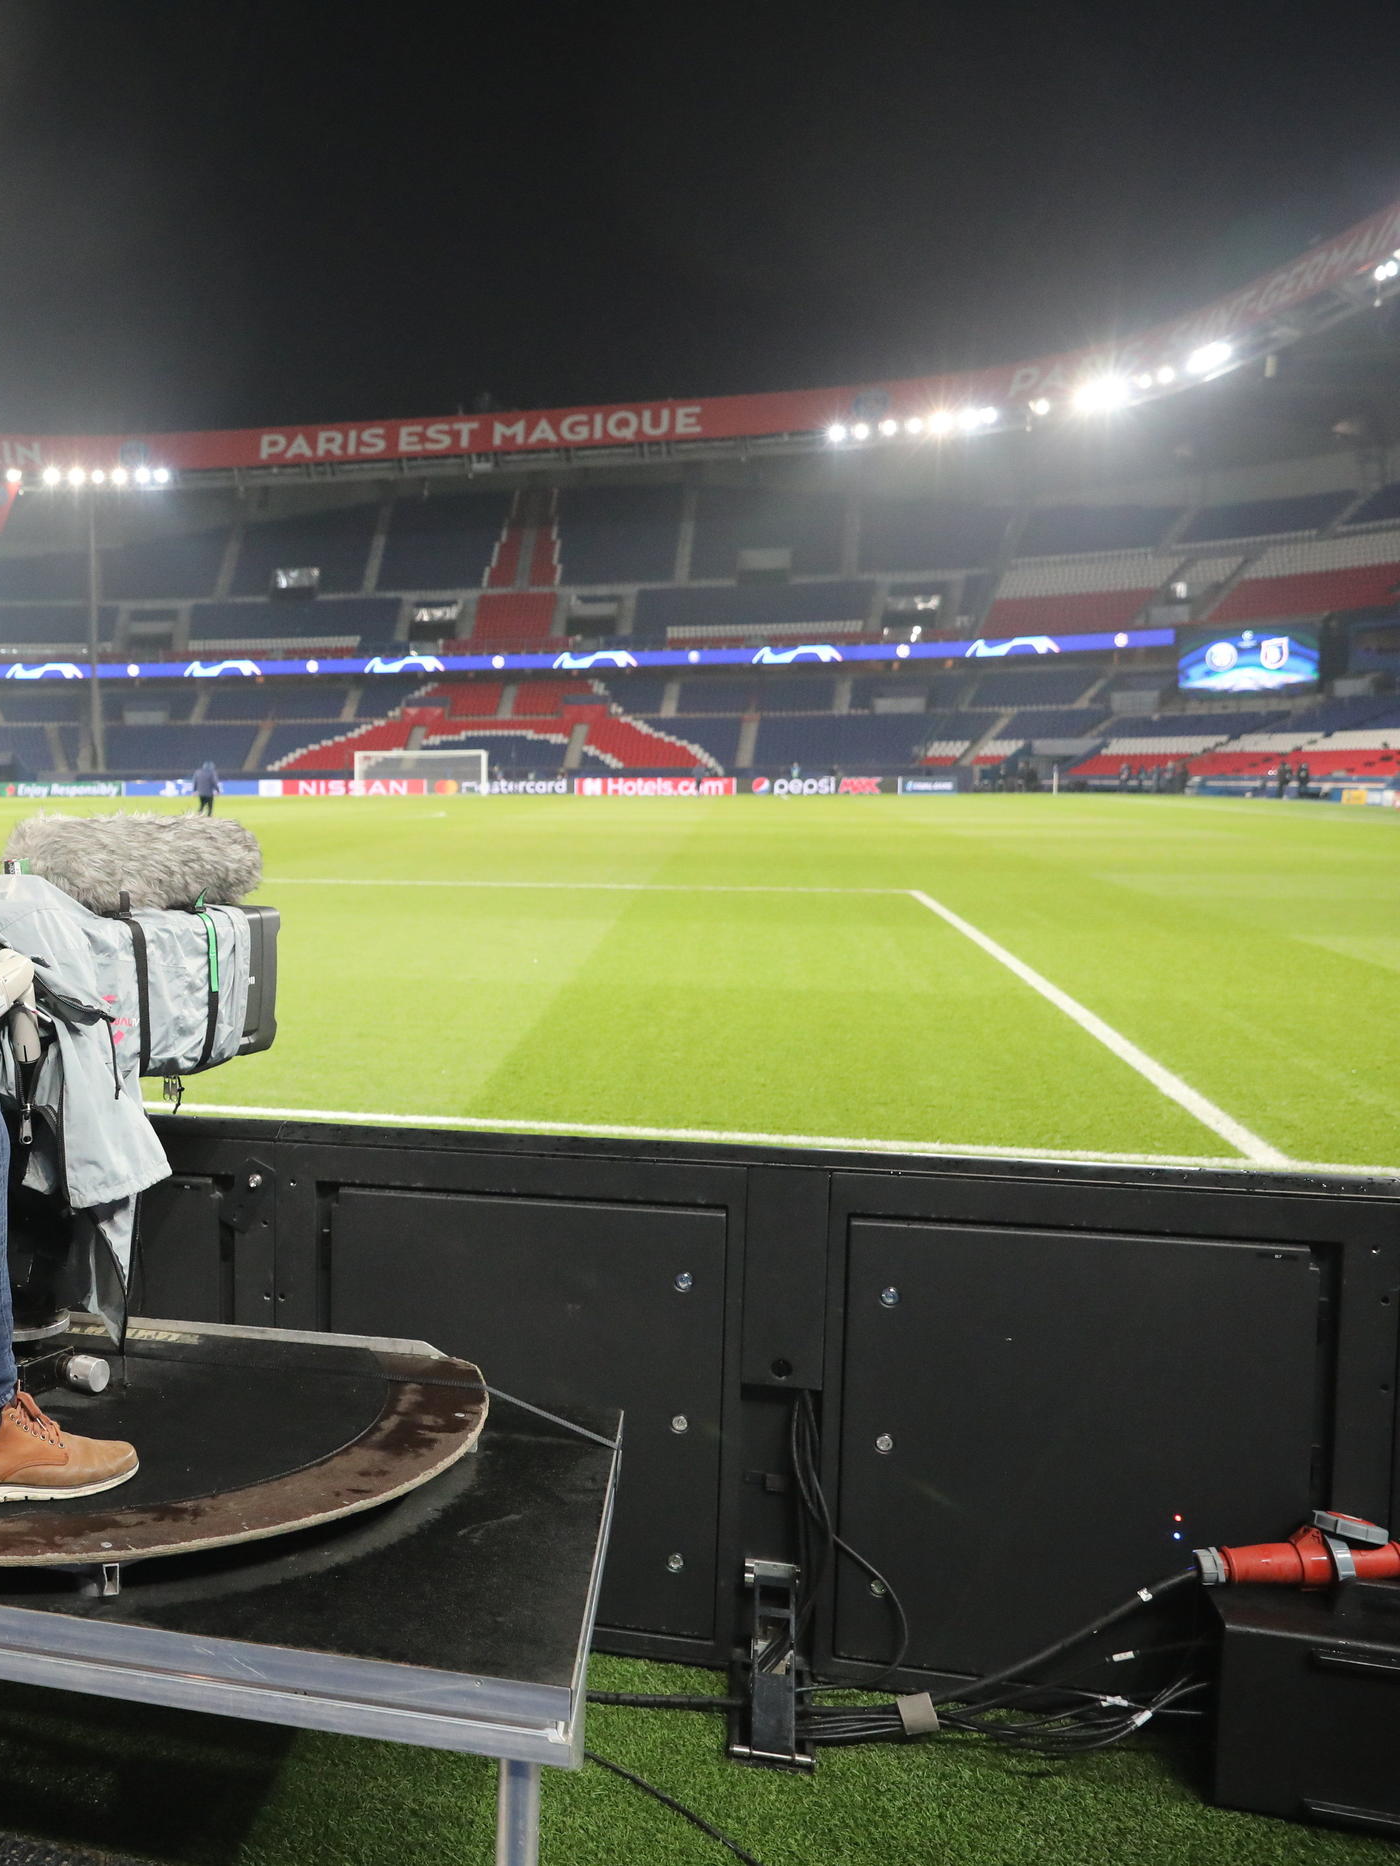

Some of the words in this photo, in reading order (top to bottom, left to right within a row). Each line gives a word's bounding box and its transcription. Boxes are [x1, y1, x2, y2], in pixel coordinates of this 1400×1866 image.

[259, 428, 387, 460] PARIS
[397, 422, 480, 453] EST
[492, 406, 703, 446] MAGIQUE
[17, 782, 49, 797] Enjoy
[51, 782, 120, 797] Responsibly
[299, 779, 409, 796] NISSAN
[774, 776, 836, 796] pepsi
